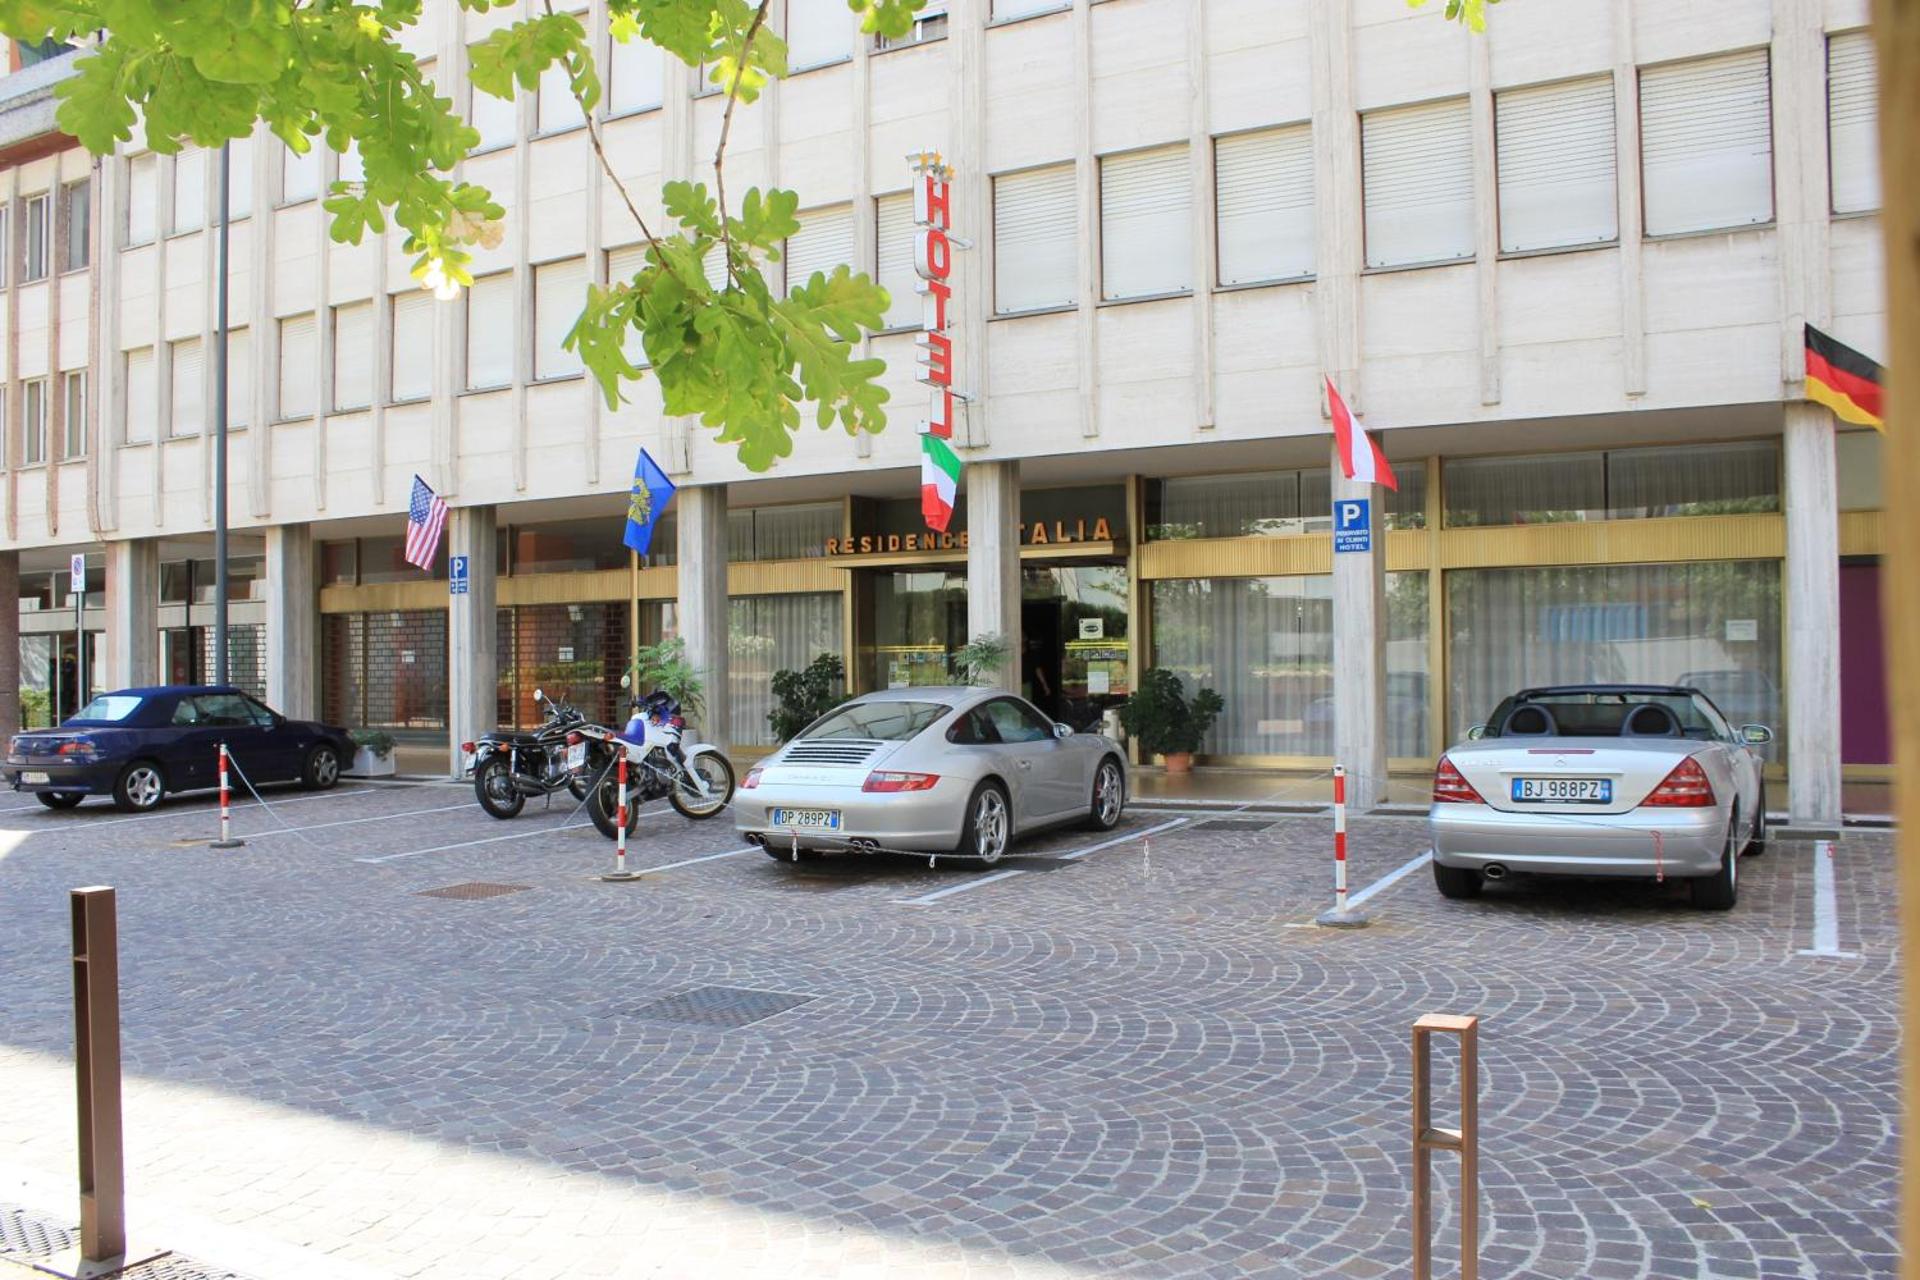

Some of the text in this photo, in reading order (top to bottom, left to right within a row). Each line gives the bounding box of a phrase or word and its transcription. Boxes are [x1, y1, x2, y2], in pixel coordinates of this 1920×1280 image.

[1343, 504, 1360, 527] P
[825, 517, 1111, 555] RESIDENCE ALIA
[453, 559, 463, 578] P
[1524, 781, 1598, 798] BJ 988PZ
[781, 810, 831, 826] DP 289PZ
